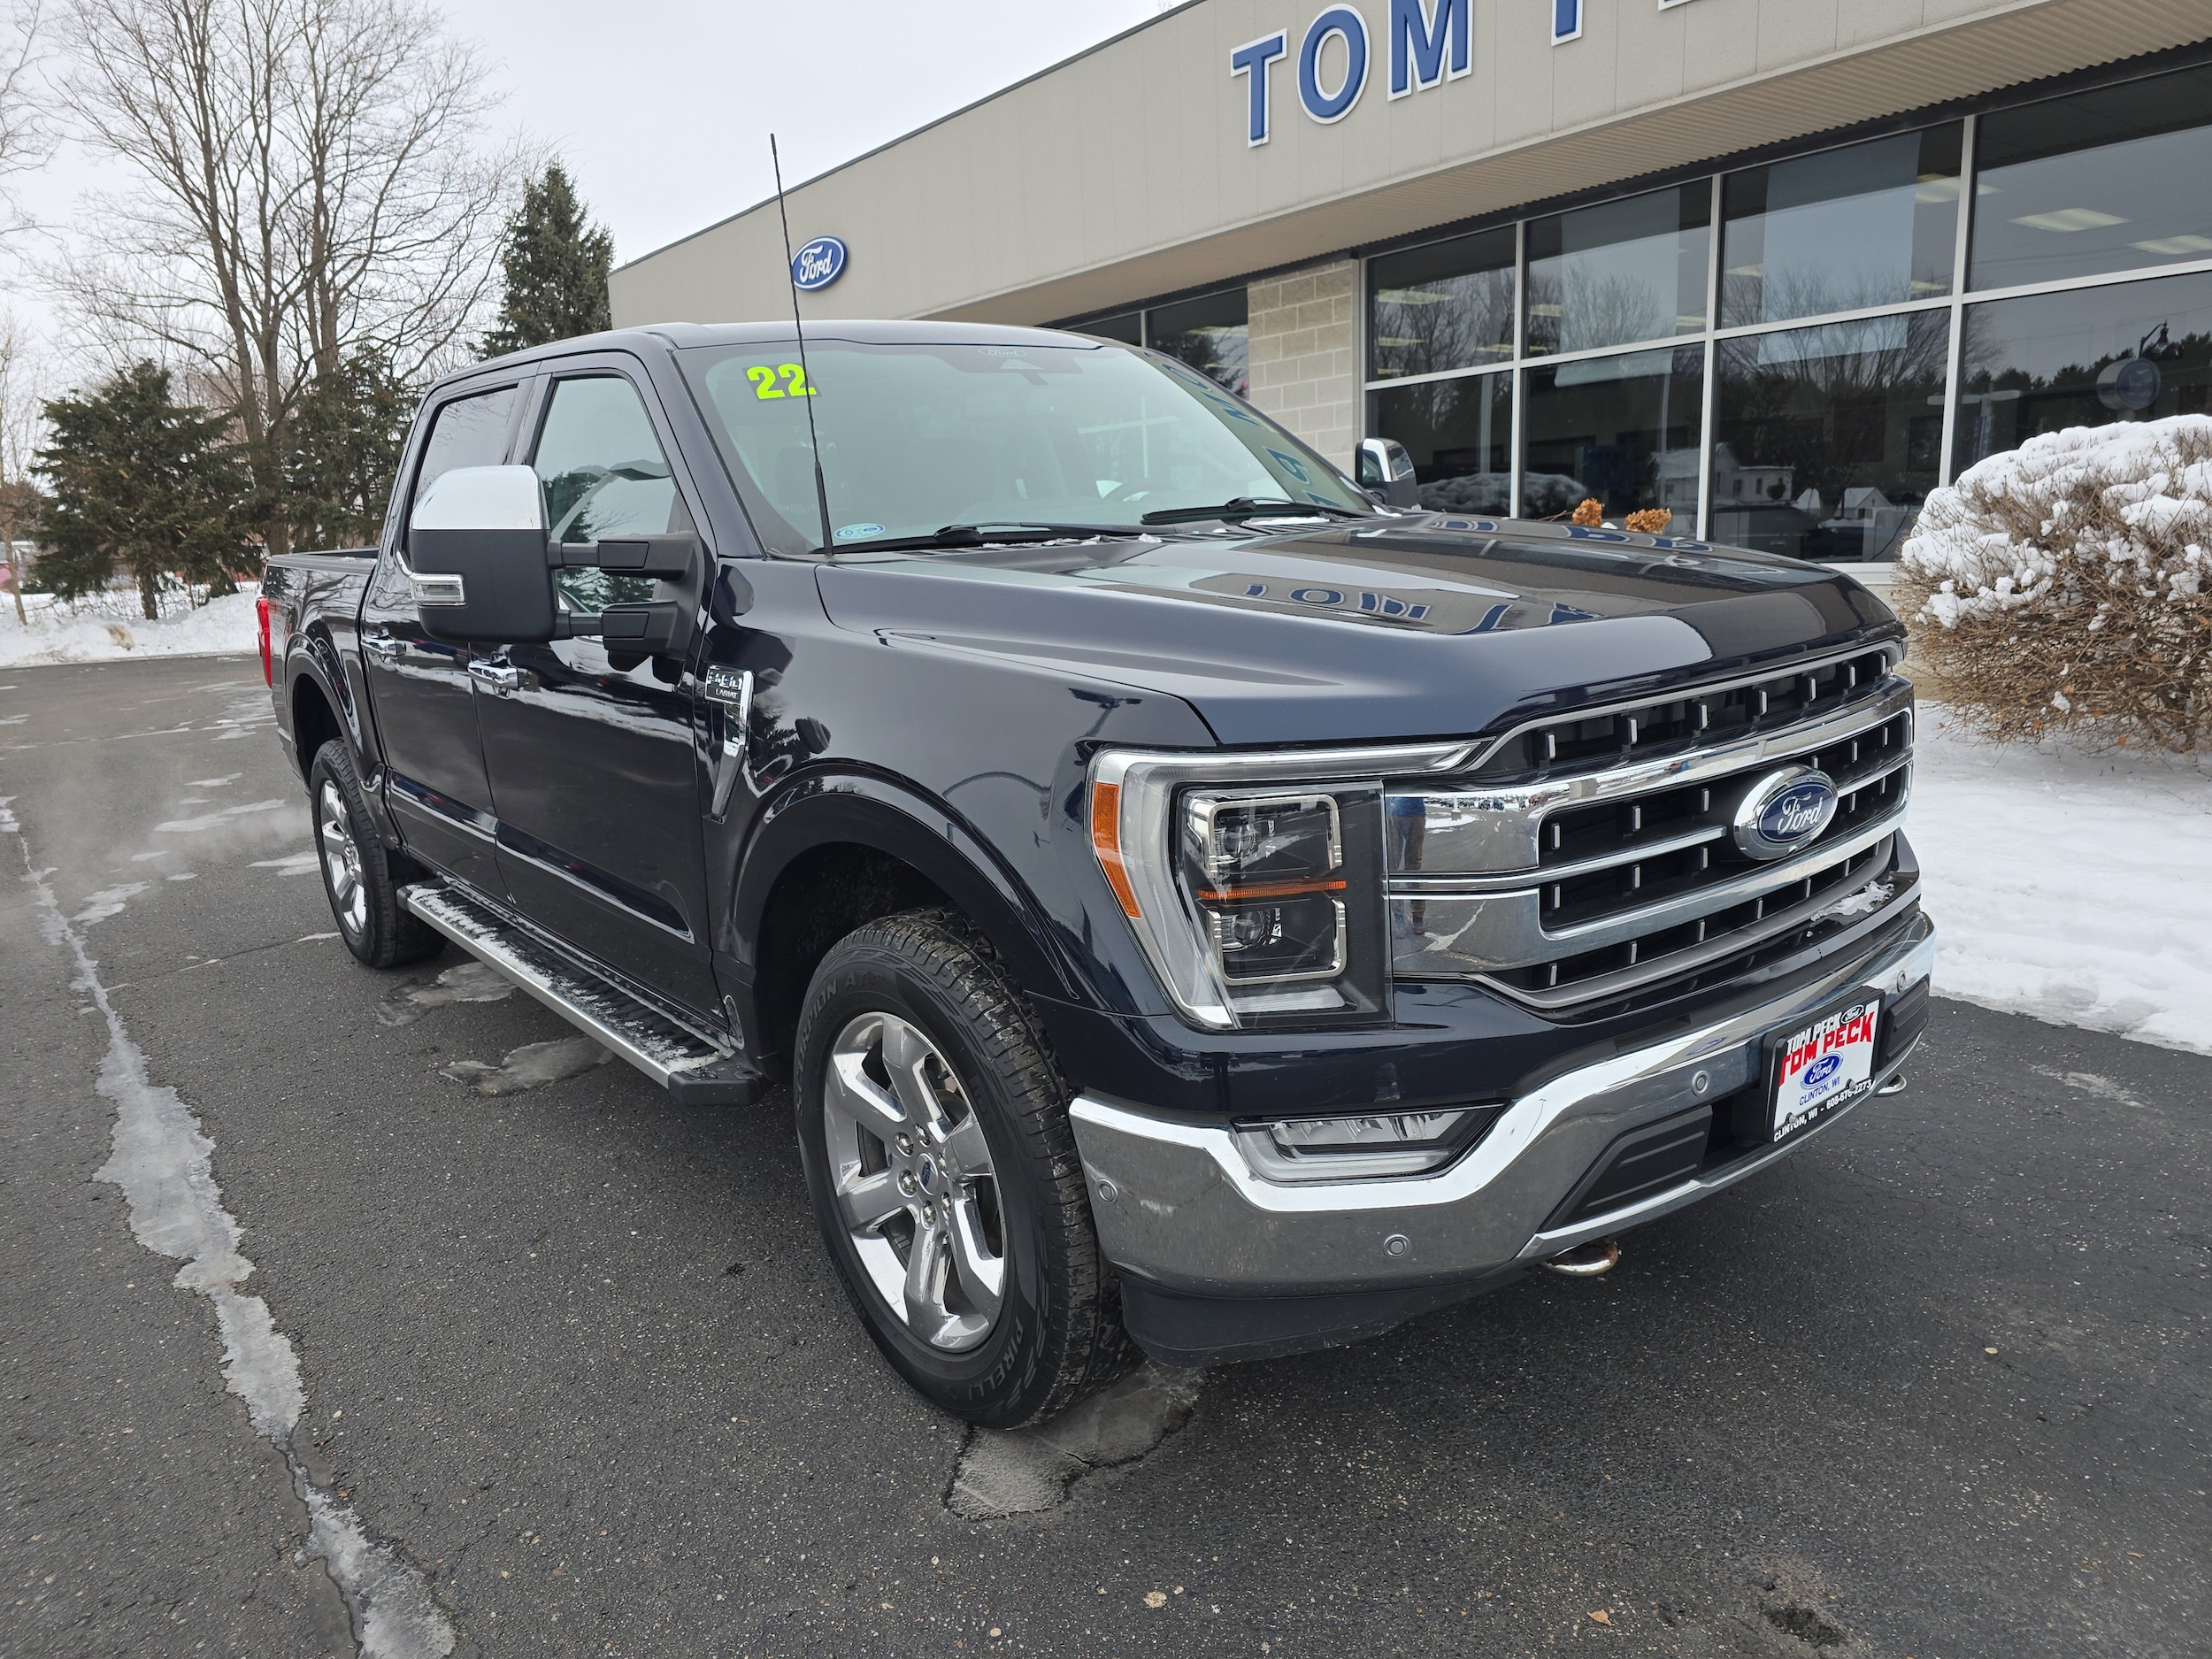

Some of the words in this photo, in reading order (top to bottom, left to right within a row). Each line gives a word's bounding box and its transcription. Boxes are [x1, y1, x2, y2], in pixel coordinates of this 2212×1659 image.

[1231, 0, 1472, 148] TOM
[799, 245, 833, 282] Ford
[747, 363, 817, 400] 22
[715, 688, 738, 699] LARIAT
[1778, 792, 1823, 835] Ford
[1779, 1040, 1816, 1087] TOM
[1823, 1010, 1875, 1053] PECK
[1787, 1027, 1812, 1056] TOM
[1812, 1011, 1843, 1041] PECK
[1809, 1058, 1834, 1083] Ford
[1800, 1084, 1830, 1106] CLINTON,
[1832, 1075, 1840, 1089] WI
[1808, 1107, 1818, 1121] WI
[968, 1313, 1024, 1401] PIRELLI
